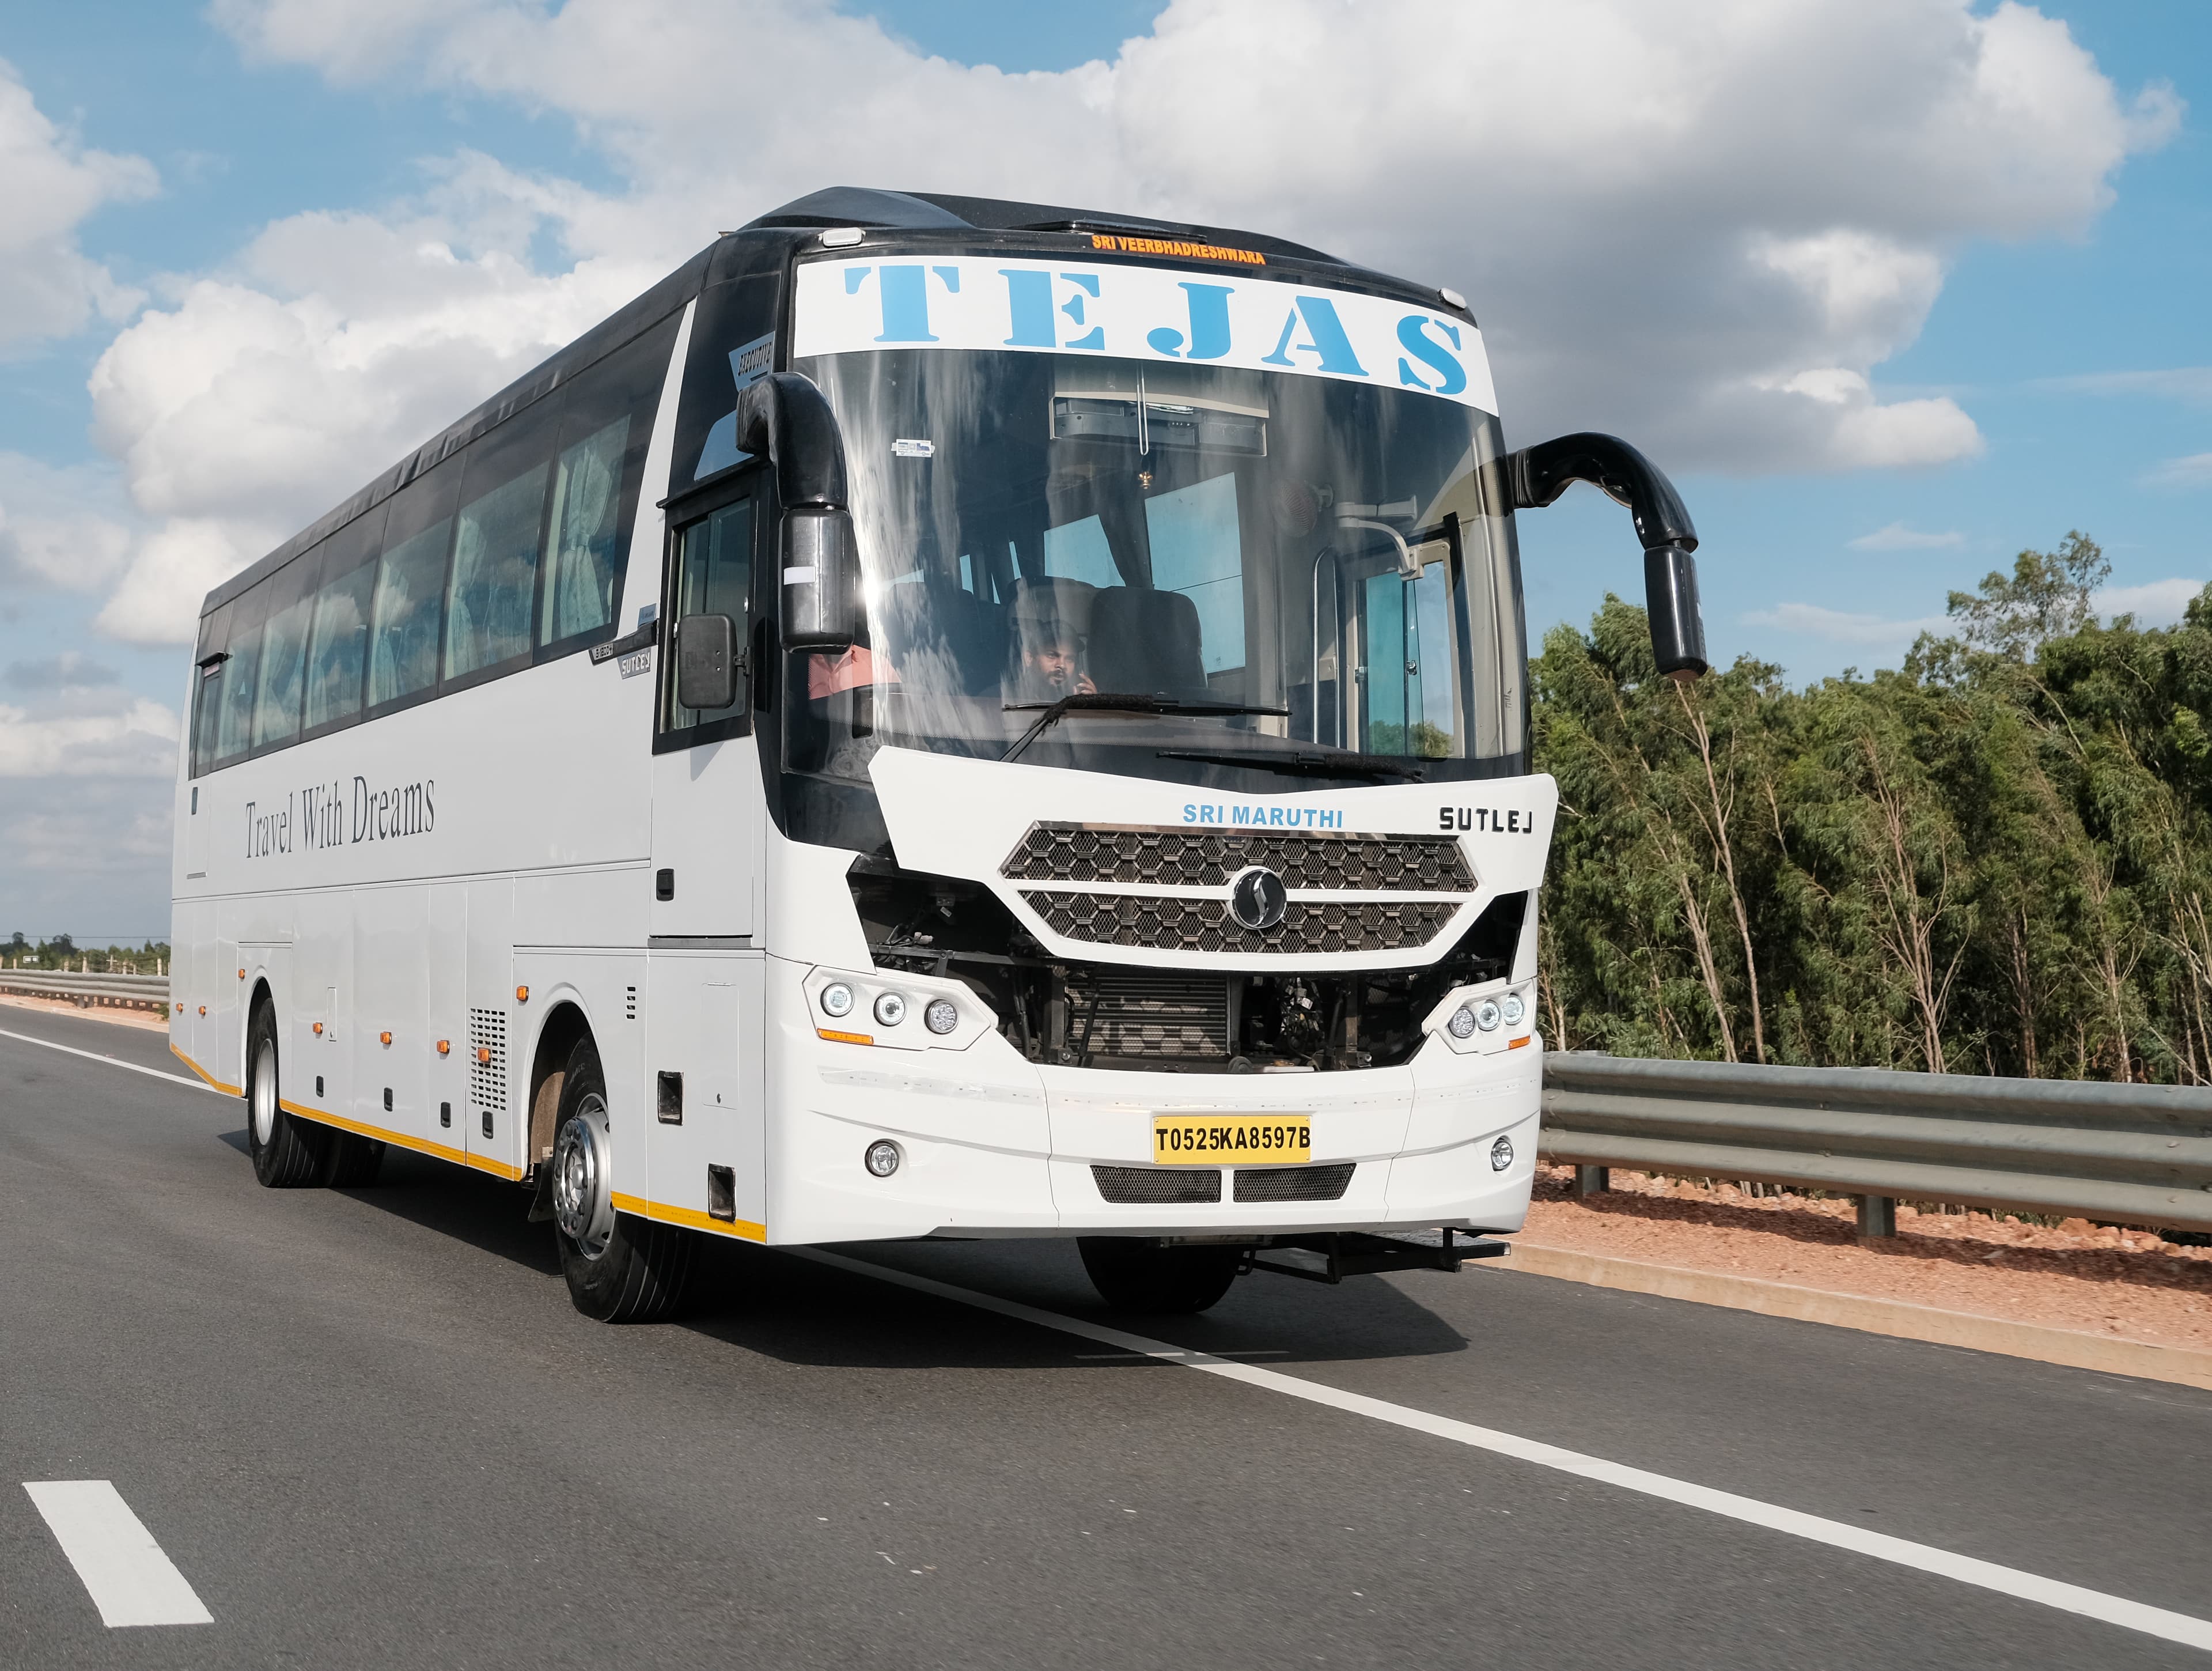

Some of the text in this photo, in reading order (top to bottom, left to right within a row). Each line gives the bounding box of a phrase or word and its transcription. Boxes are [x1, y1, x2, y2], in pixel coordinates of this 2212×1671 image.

[1092, 235, 1266, 265] SRI VEERBHADRESHWARA
[844, 265, 1467, 395] TEJAS
[738, 341, 772, 376] EXECUTIVE
[246, 776, 434, 859] Travel With Dreams
[1183, 804, 1343, 829] SRI MARUTHI
[1439, 807, 1532, 834] SUTLEJ
[1156, 1126, 1310, 1151] T0525KA8597B
